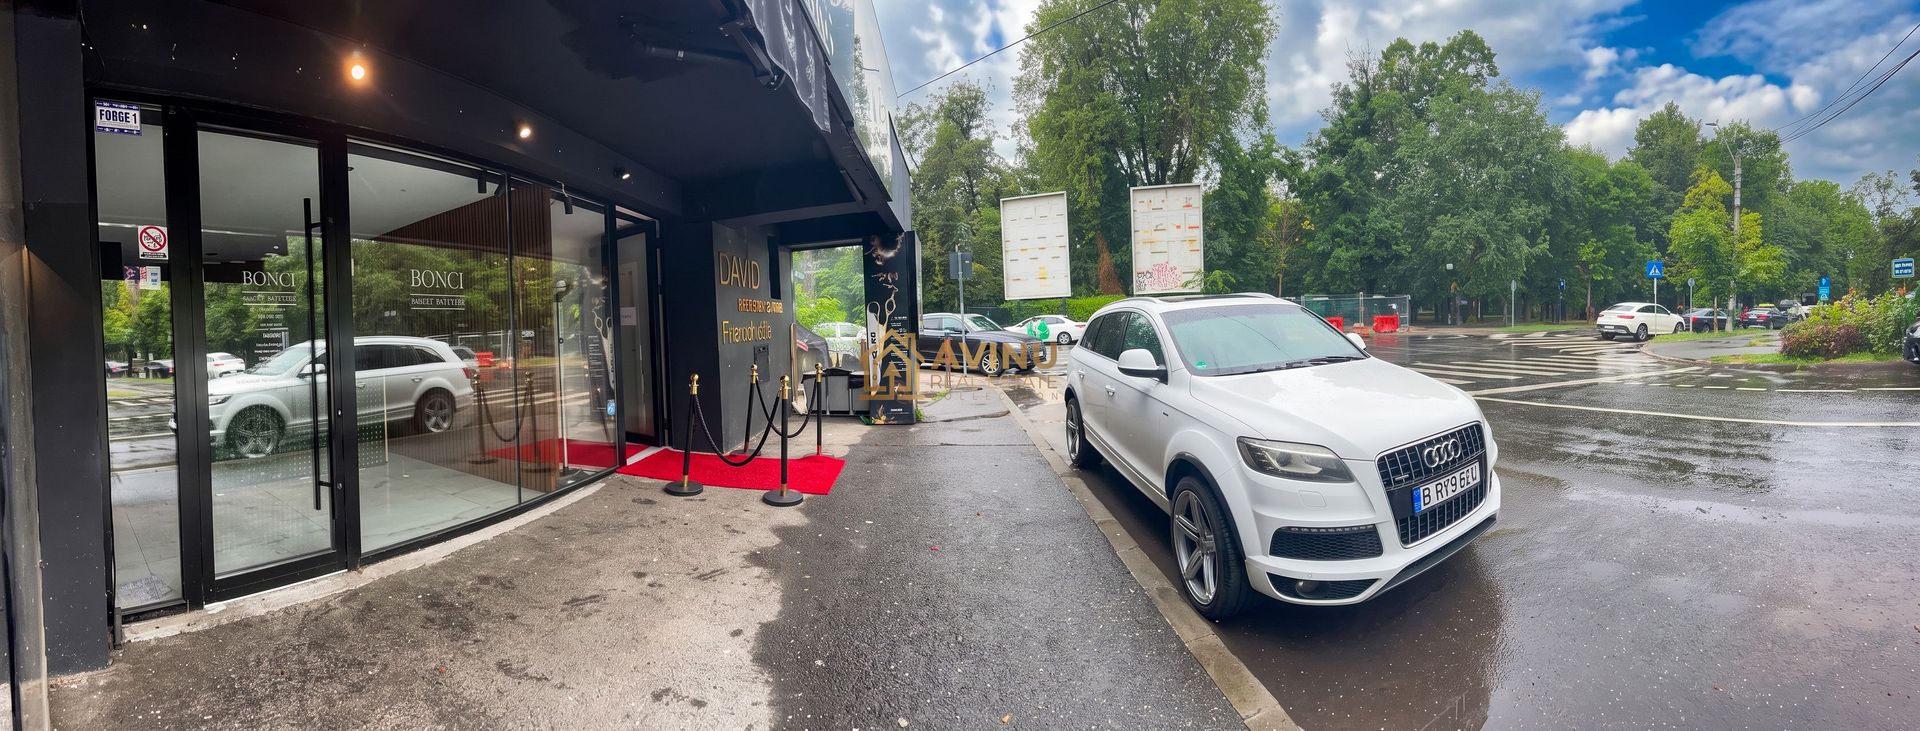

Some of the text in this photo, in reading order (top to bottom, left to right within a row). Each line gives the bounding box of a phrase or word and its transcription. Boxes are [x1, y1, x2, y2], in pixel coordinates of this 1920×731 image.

[100, 109, 137, 124] FORGE 1
[242, 270, 296, 288] BONCI
[409, 268, 464, 290] BONCI
[719, 252, 760, 290] DAVID
[1422, 487, 1432, 507] B
